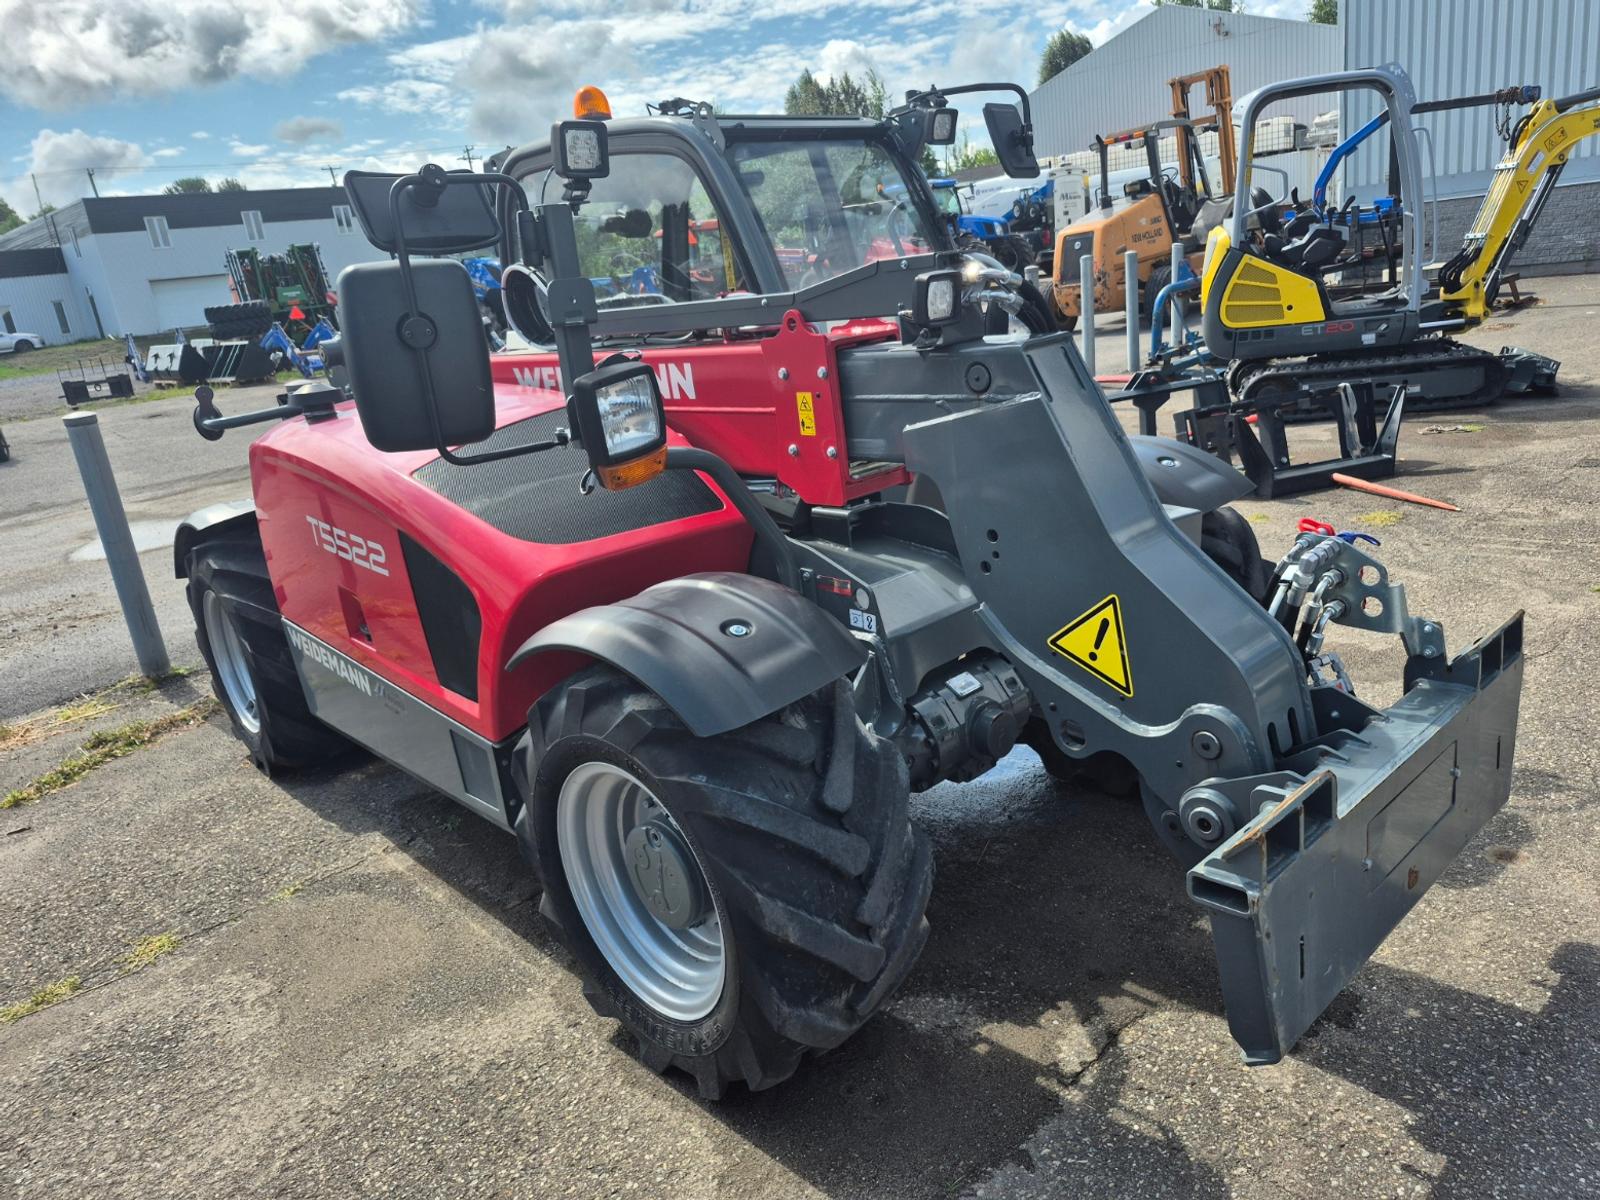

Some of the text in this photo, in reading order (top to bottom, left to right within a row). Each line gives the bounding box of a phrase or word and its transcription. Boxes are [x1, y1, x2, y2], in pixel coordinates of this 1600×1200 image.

[1301, 322, 1355, 336] ET20
[305, 514, 390, 577] T5522
[286, 625, 372, 697] WEIDEMANN
